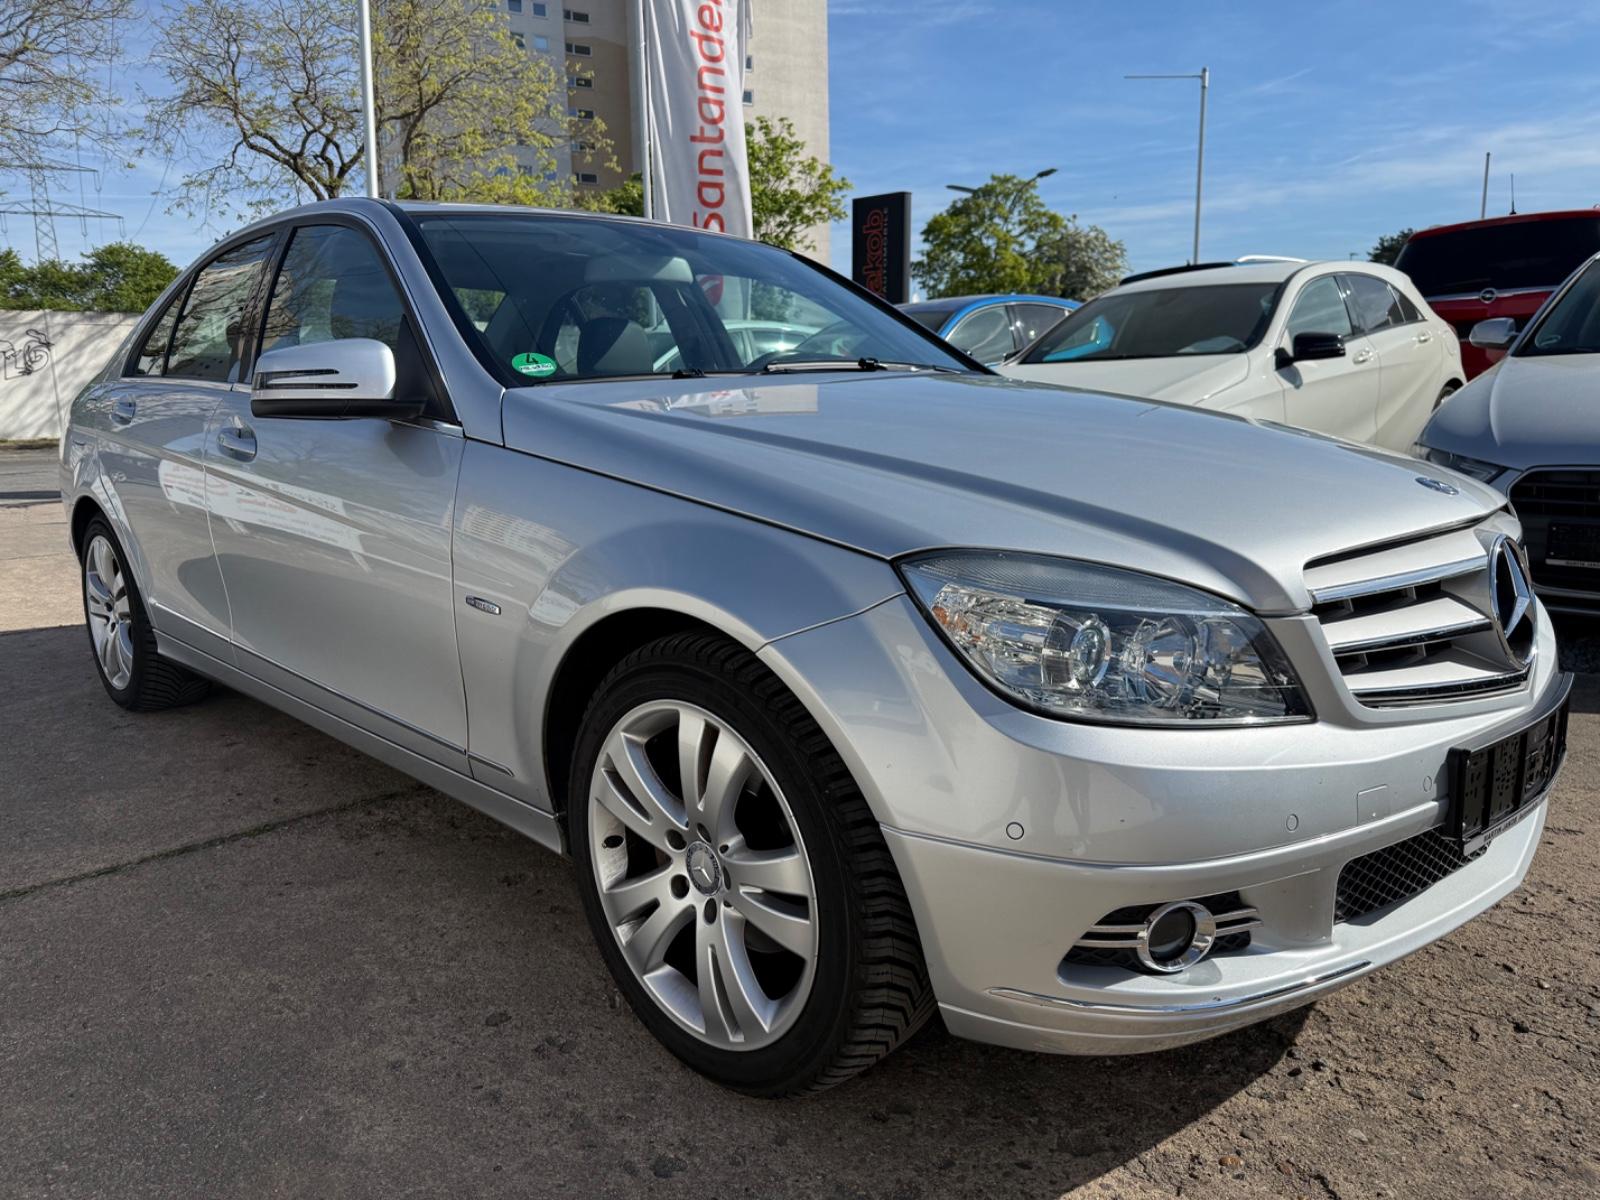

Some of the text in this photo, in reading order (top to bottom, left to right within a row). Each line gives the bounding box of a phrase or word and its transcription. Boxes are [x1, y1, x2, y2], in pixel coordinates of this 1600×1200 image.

[689, 0, 725, 233] Santande
[863, 209, 885, 296] akob
[526, 353, 539, 365] 4
